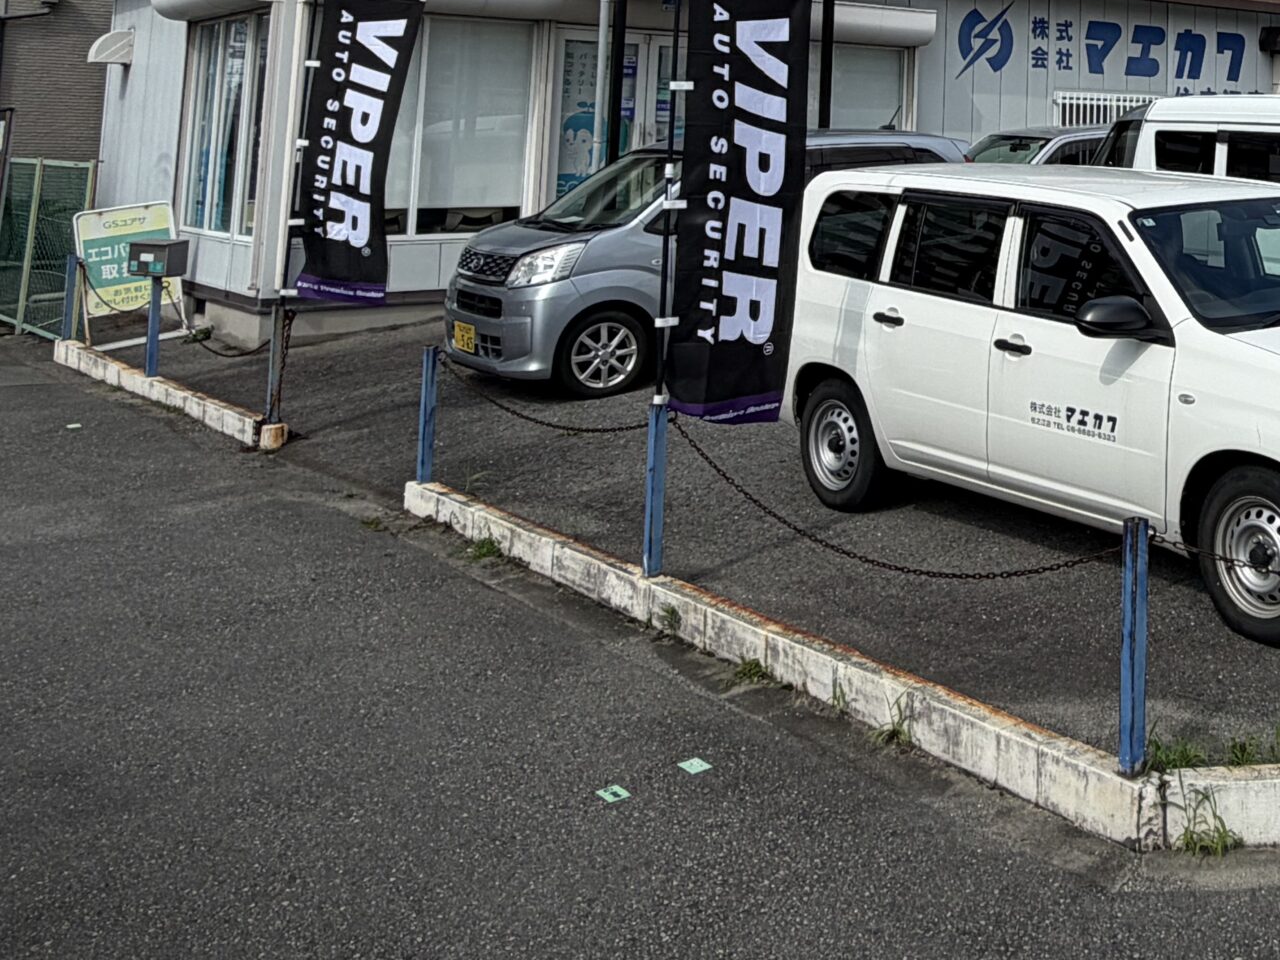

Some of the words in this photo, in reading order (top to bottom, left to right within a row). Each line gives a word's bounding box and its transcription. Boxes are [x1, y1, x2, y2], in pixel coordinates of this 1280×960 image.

[332, 9, 354, 82] AUTO
[711, 2, 731, 110] AUTO
[1084, 20, 1246, 82] マエカワ
[313, 98, 340, 238] SECURITY
[326, 18, 408, 249] VIPER
[719, 18, 790, 345] VIPER
[697, 136, 728, 344] SECURITY
[1030, 401, 1061, 418] 株式会社
[1066, 406, 1117, 433] マエカワ
